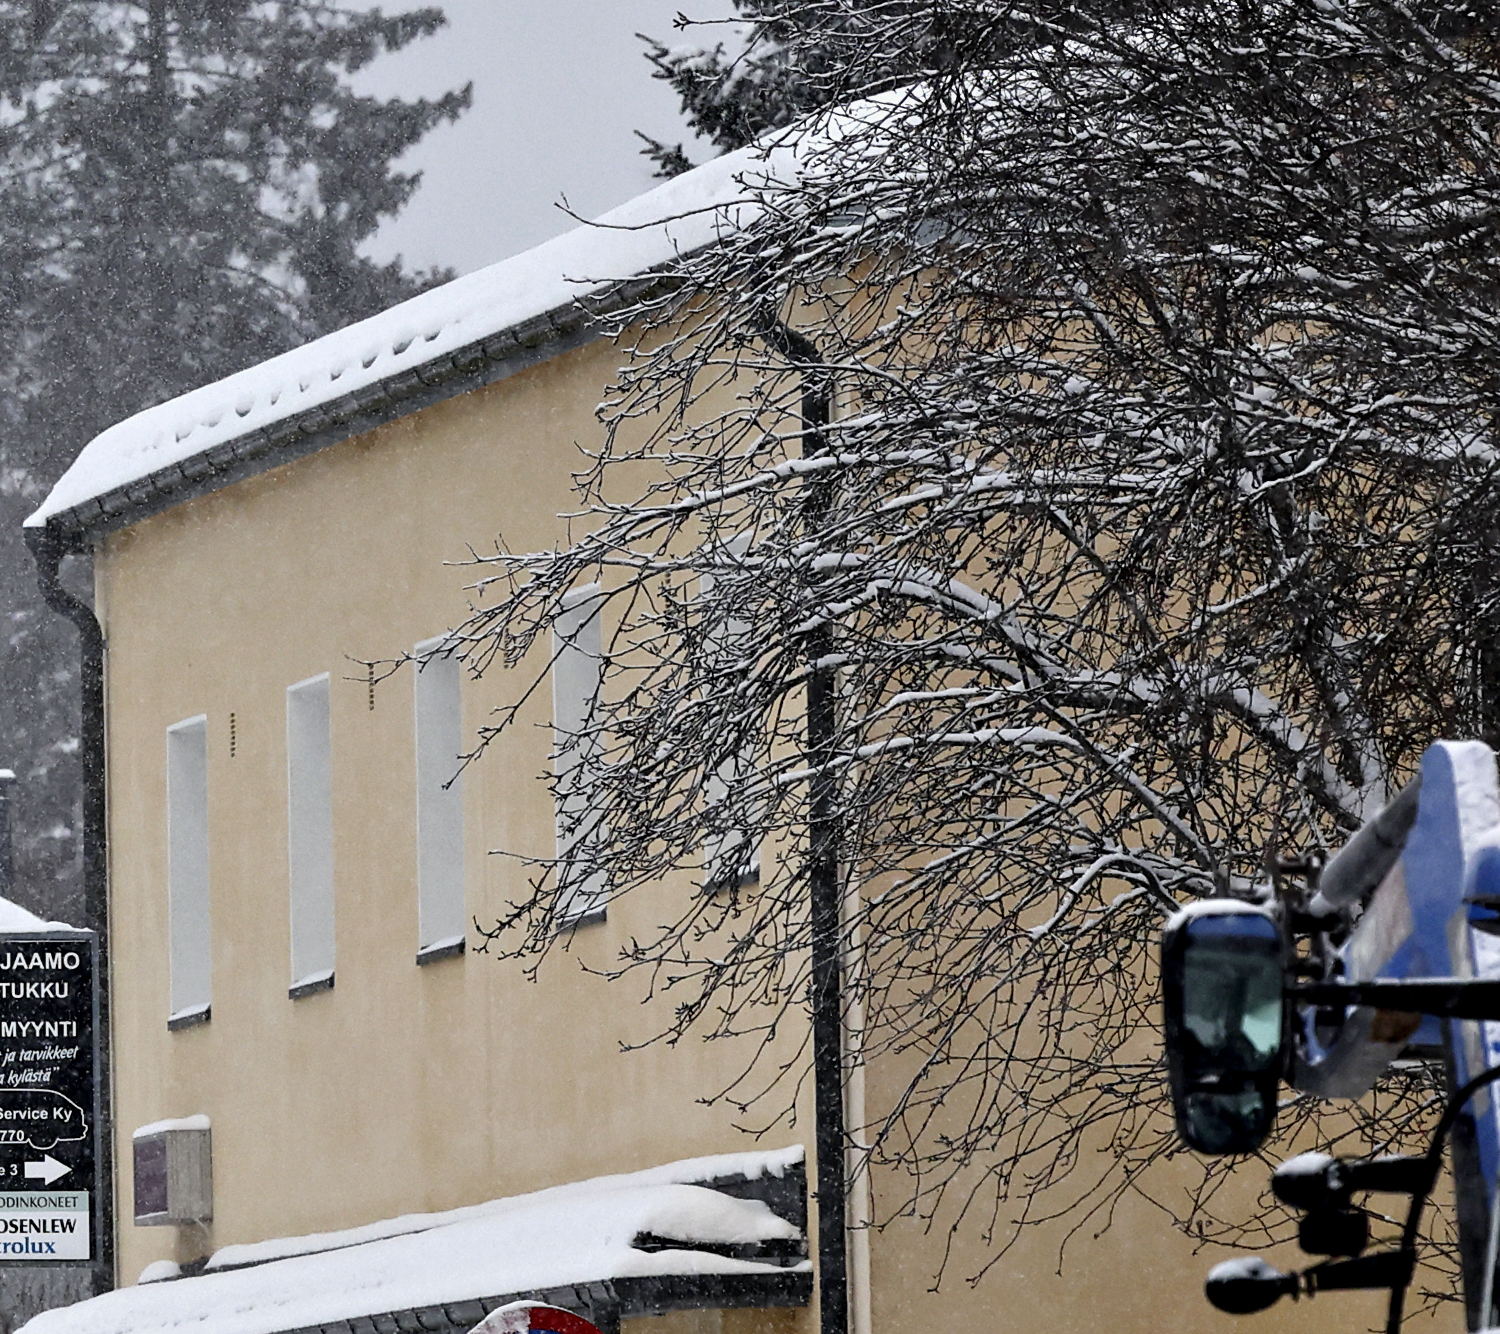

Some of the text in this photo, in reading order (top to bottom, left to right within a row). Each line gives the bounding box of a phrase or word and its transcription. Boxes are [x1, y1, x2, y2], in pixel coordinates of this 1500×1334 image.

[2, 1048, 16, 1067] ja
[19, 1045, 79, 1062] tarvikkeet
[53, 1107, 73, 1123] Ky
[9, 1164, 18, 1176] 3
